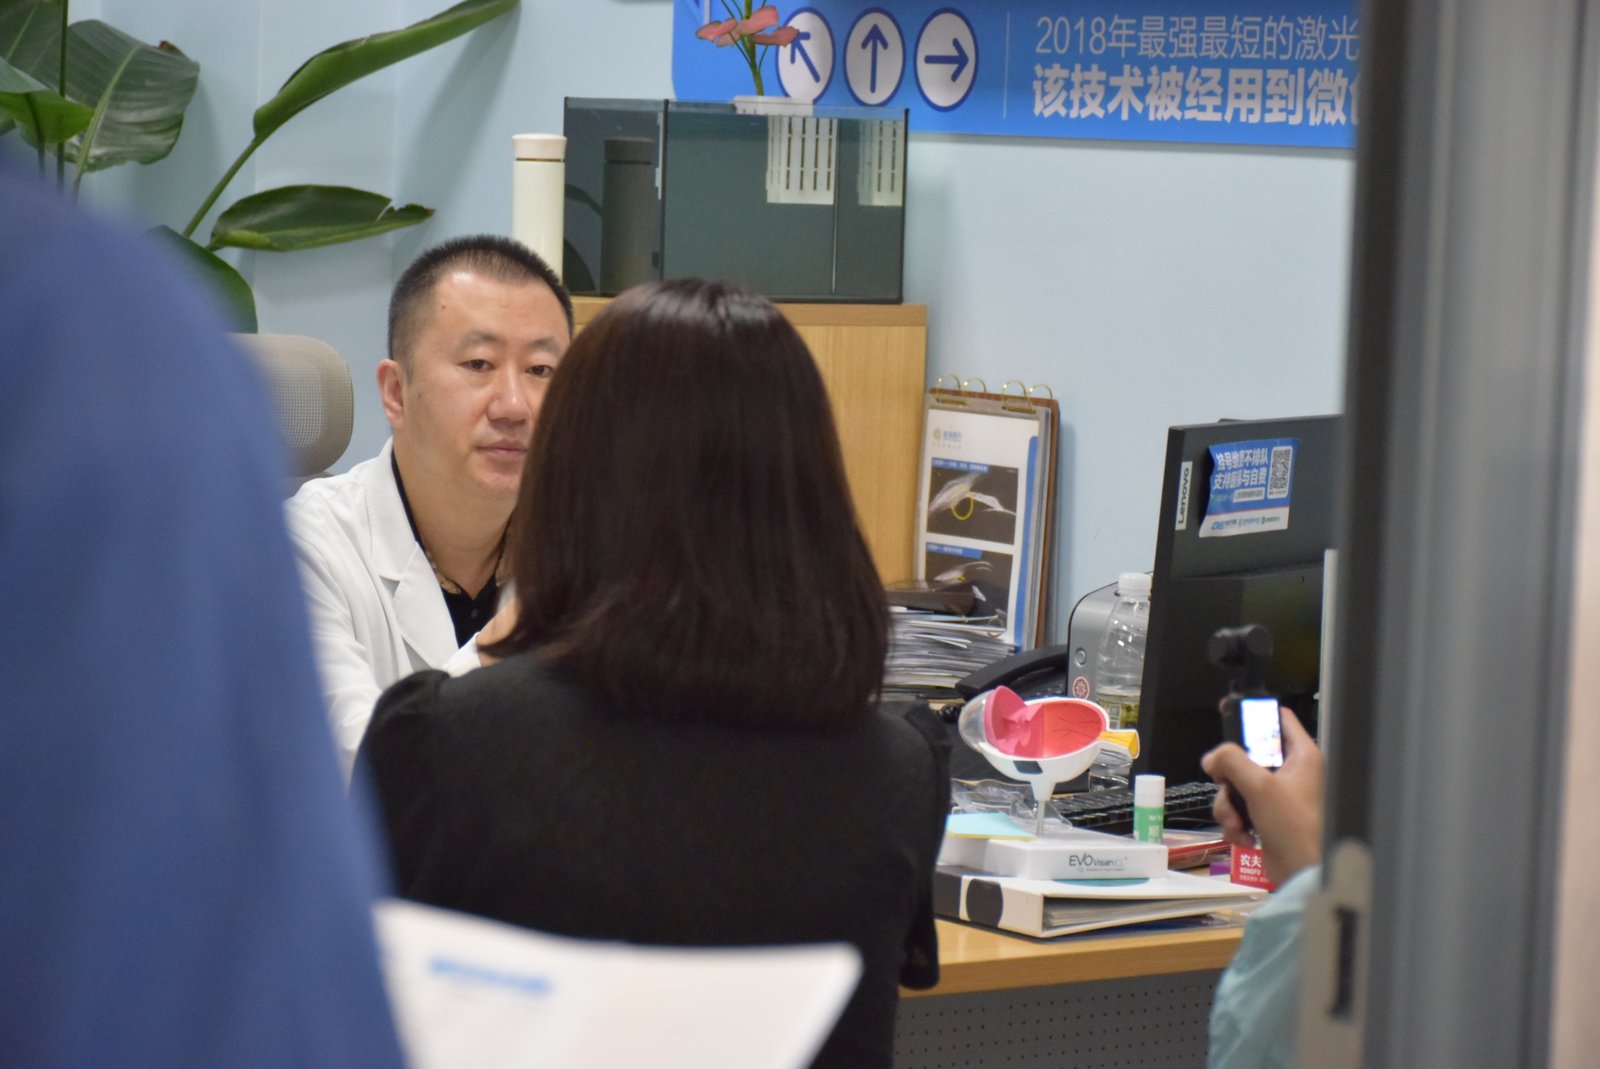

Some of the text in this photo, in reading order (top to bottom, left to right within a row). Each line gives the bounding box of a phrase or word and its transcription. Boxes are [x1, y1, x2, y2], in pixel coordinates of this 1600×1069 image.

[1036, 14, 1358, 61] 2018年最强最短的激光
[1033, 63, 1359, 126] 该技术被经用到微
[1069, 852, 1094, 866] EVO
